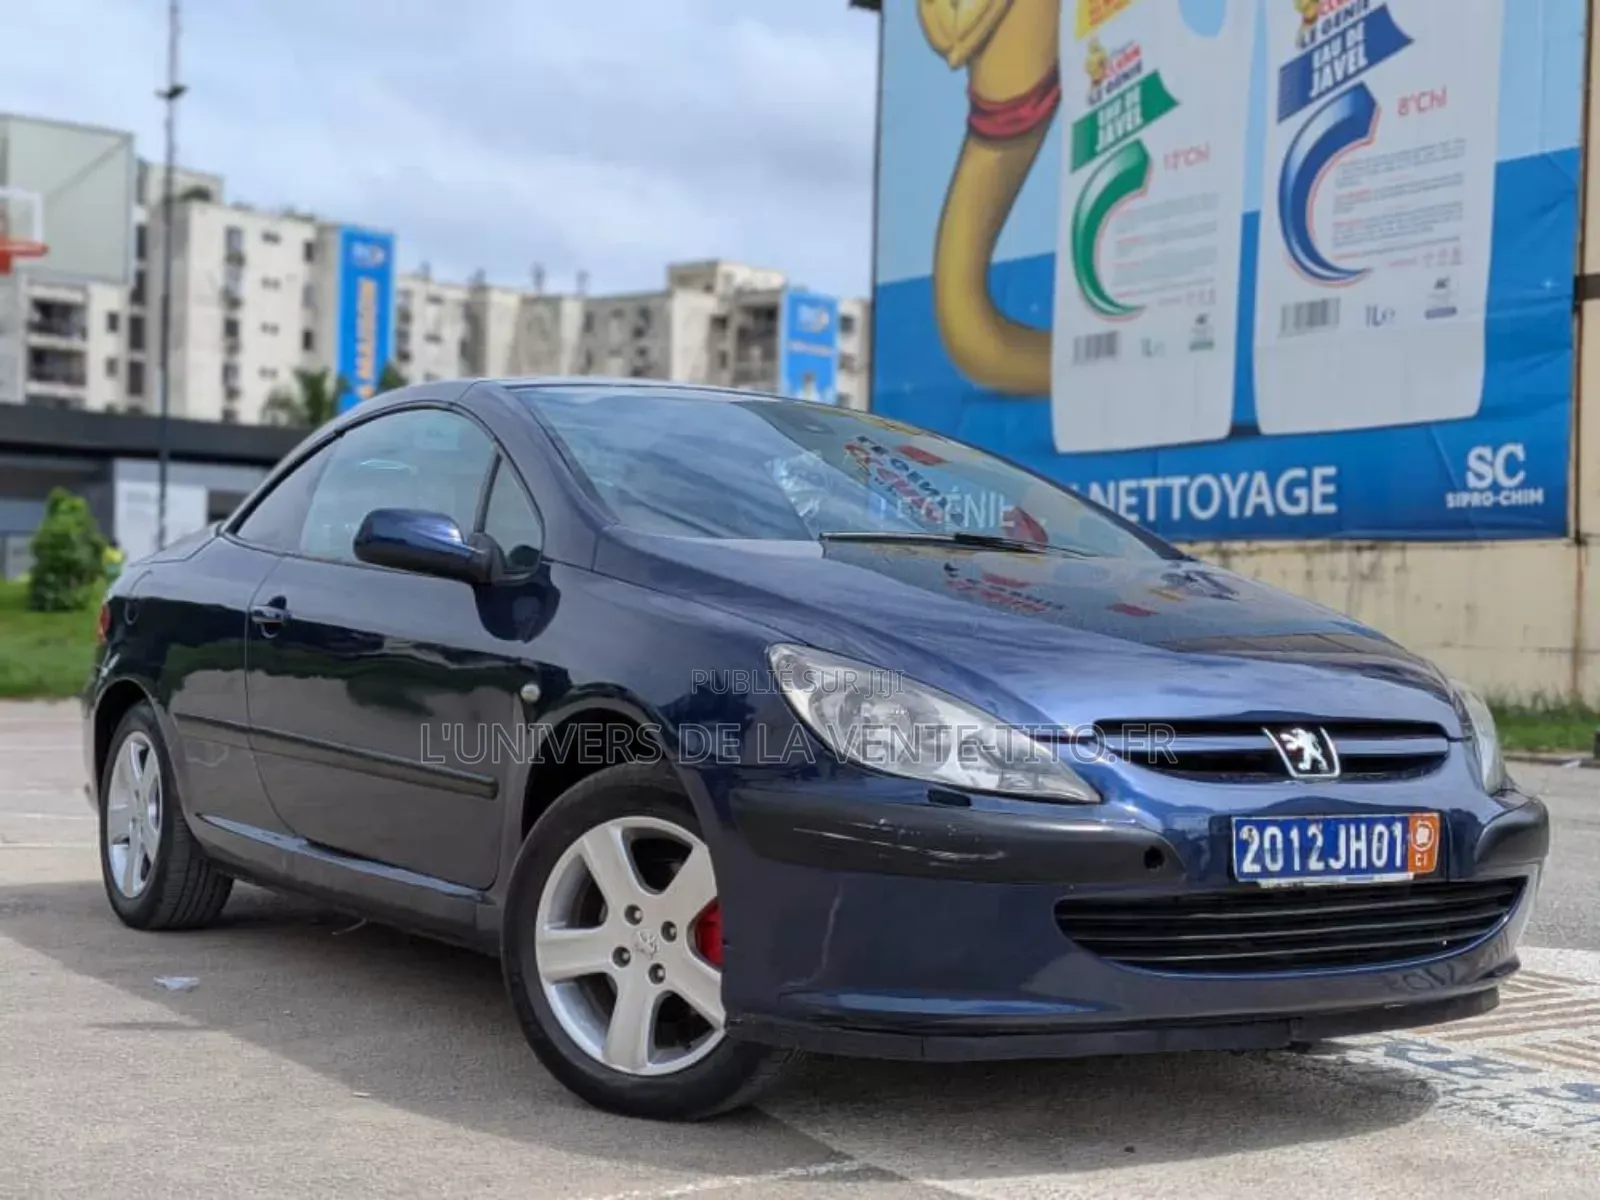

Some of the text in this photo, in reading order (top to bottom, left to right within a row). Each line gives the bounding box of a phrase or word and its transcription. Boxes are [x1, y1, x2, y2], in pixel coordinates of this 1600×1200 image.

[1309, 43, 1369, 99] JAVEL
[1466, 442, 1526, 490] SC
[1087, 465, 1338, 524] NETTOYAGE
[1445, 486, 1545, 509] SIPRO-CHIM
